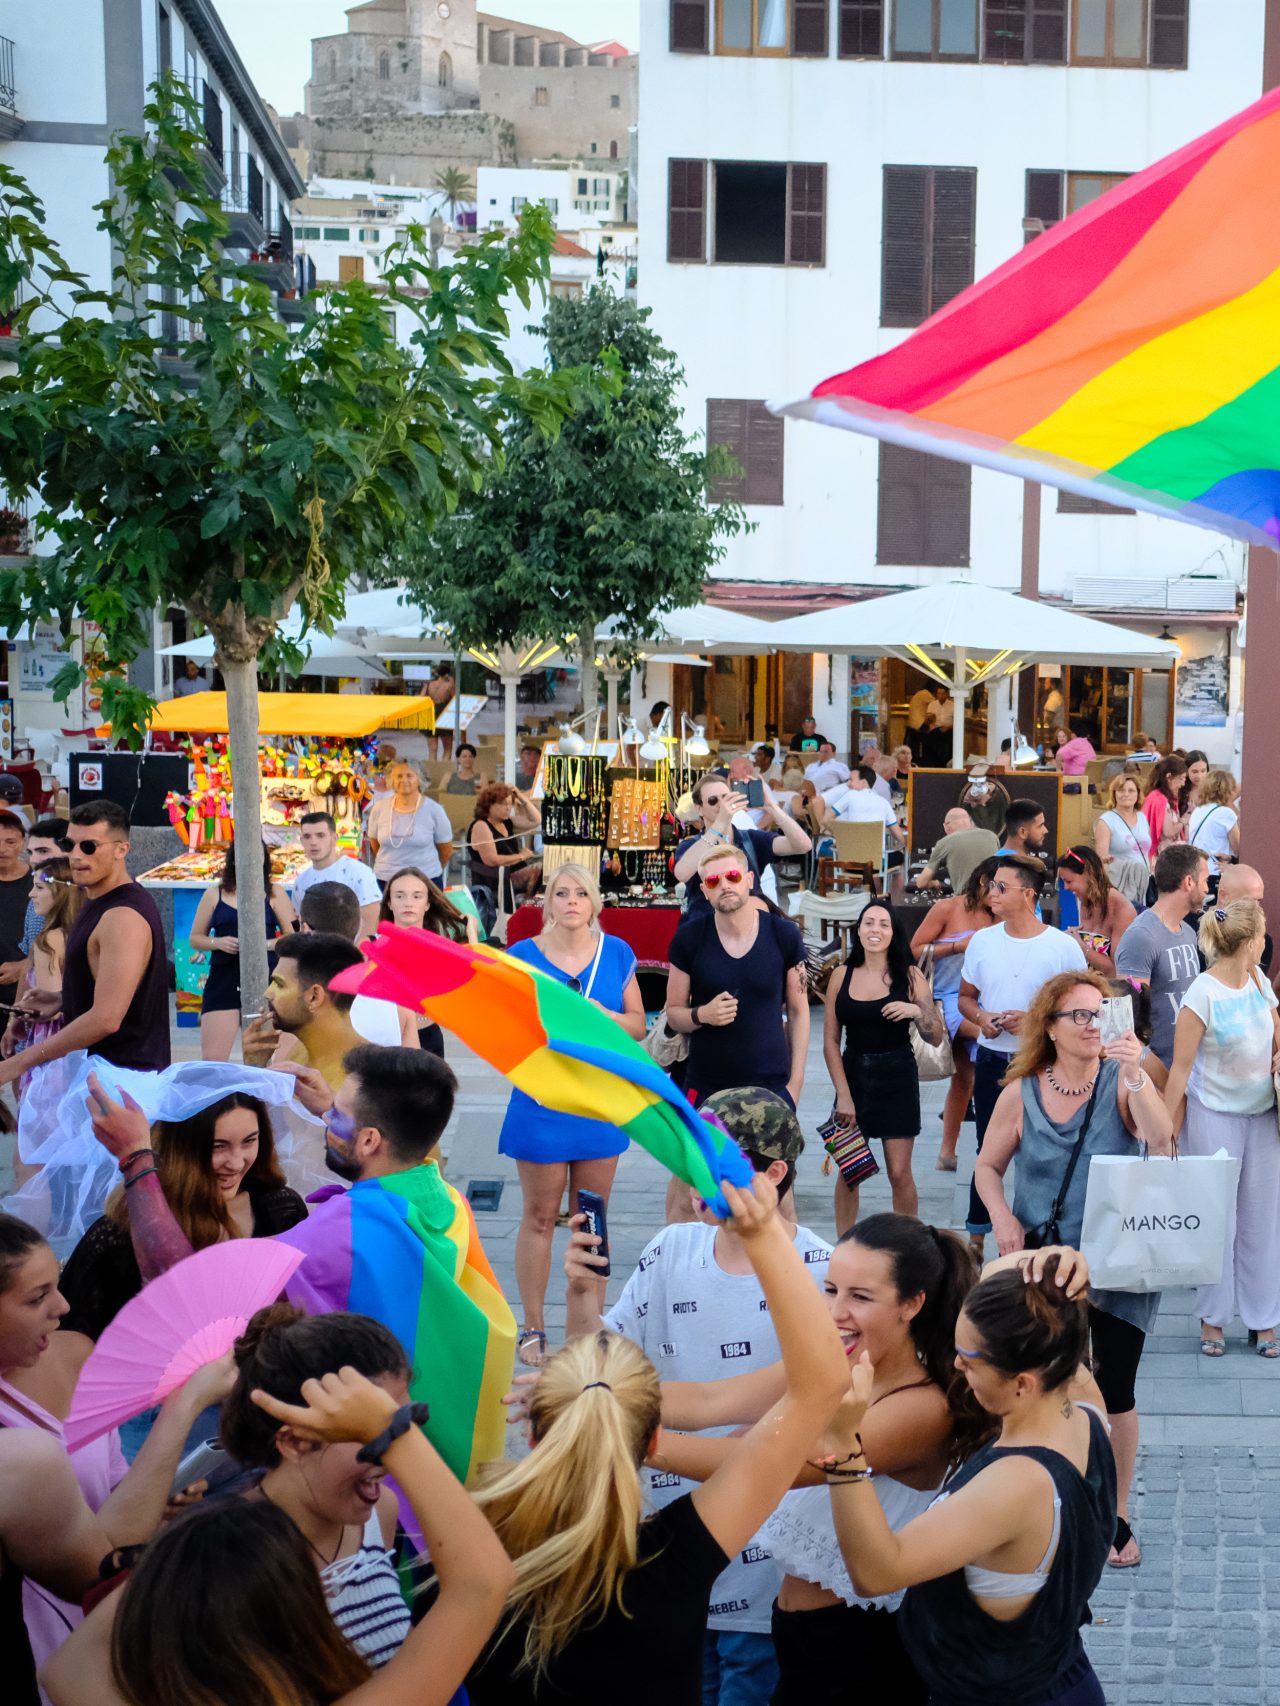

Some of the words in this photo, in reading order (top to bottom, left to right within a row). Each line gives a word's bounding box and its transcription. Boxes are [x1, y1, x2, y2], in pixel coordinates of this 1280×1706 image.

[1121, 1214, 1200, 1232] MANGO
[673, 1301, 697, 1314] RIOTS
[723, 1344, 748, 1357] 1984
